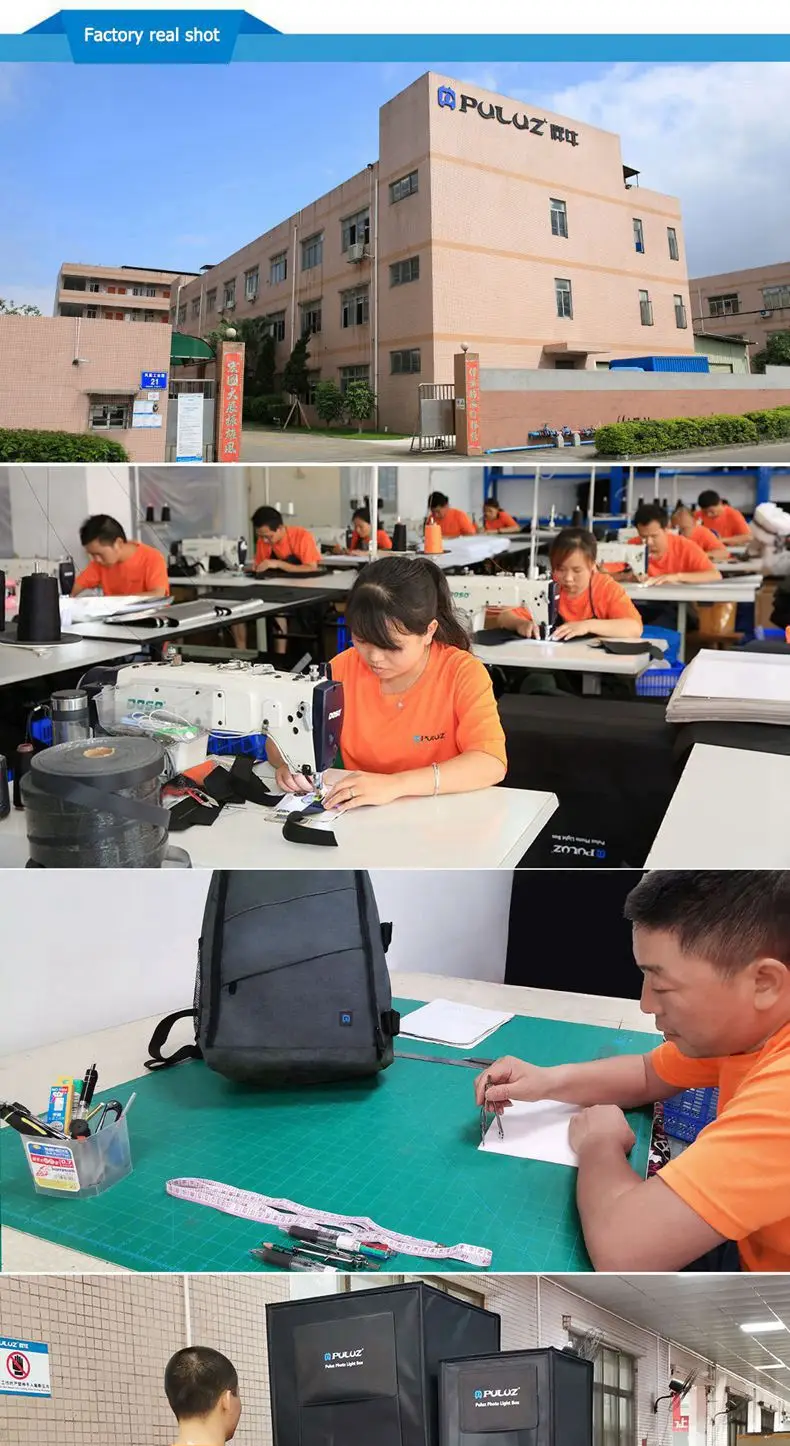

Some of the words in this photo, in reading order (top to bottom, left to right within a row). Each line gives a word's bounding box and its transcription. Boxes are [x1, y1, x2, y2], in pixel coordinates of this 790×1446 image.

[459, 94, 545, 136] PULUZ
[552, 844, 595, 857] PULUZ
[332, 1348, 364, 1360] PULUZ
[483, 1388, 519, 1398] PULUZ
